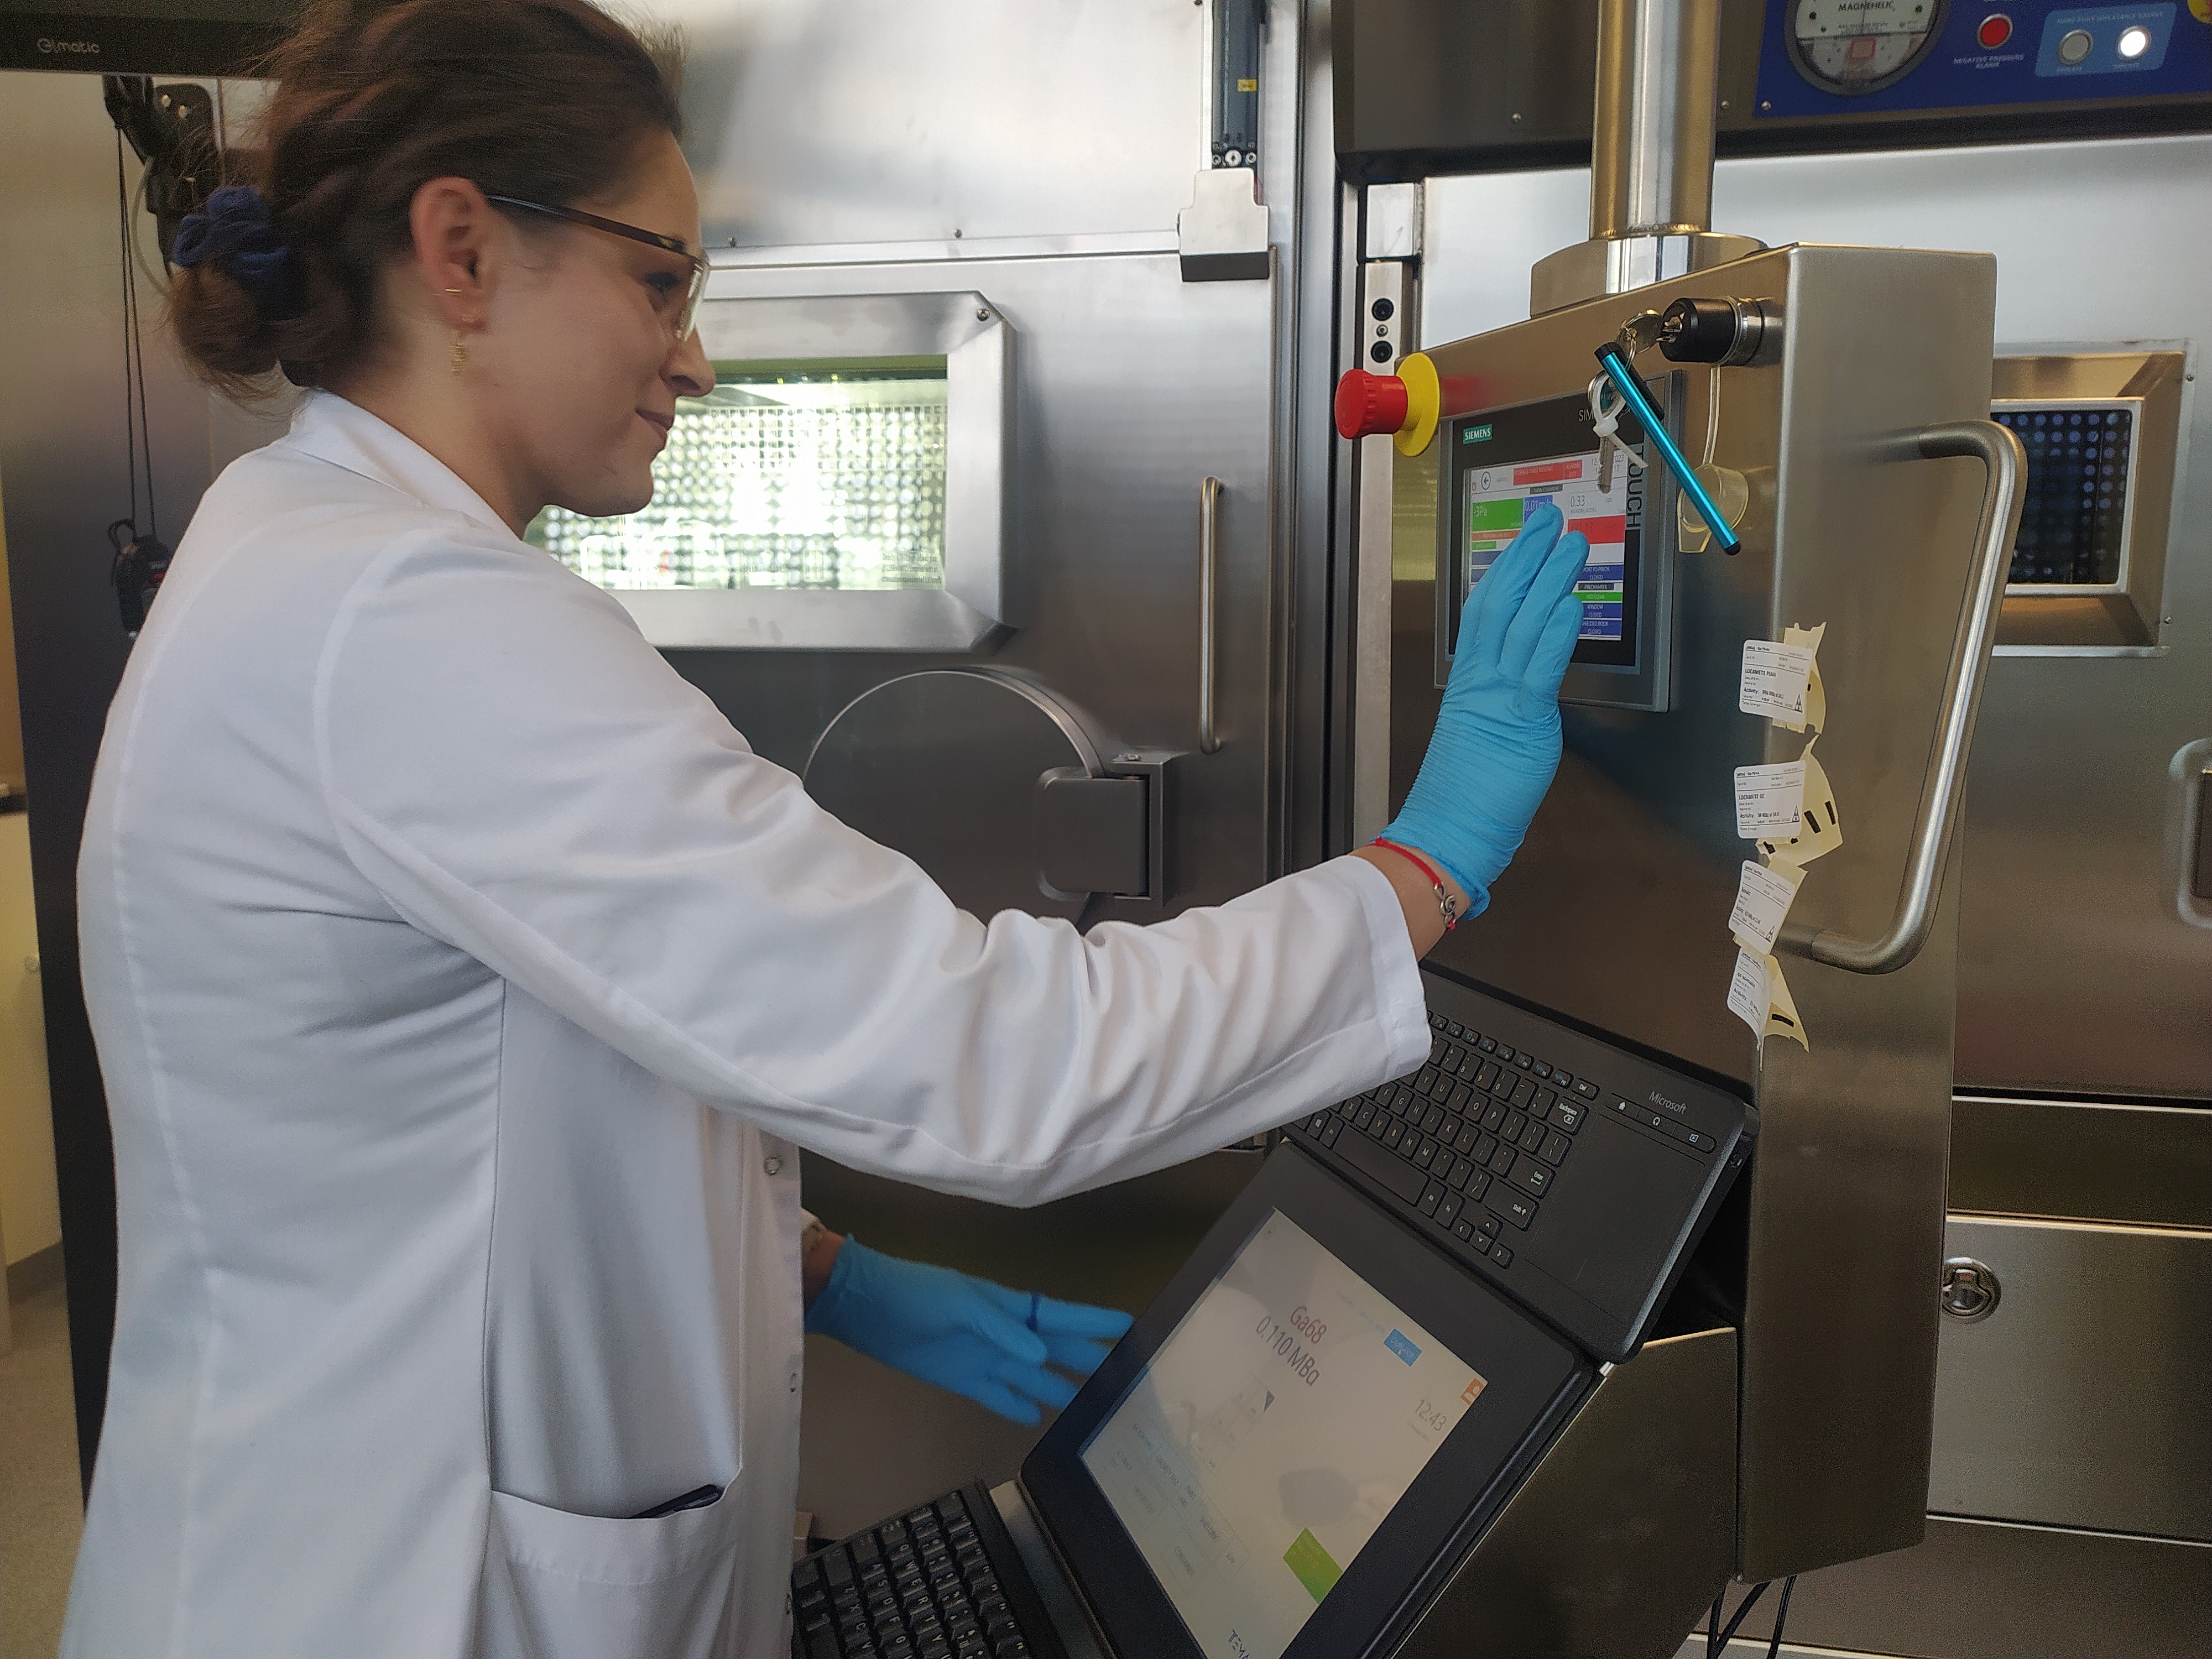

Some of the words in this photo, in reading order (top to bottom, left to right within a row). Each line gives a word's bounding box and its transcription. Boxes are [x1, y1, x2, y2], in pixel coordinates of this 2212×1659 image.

[1465, 427, 1491, 441] SIEMENS
[1424, 1076, 1430, 1084] Y
[1648, 1091, 1687, 1115] Microsoft
[1413, 1106, 1420, 1114] H
[1446, 1124, 1452, 1133] K
[1463, 1134, 1468, 1142] L
[1406, 1138, 1413, 1147] N
[1422, 1148, 1430, 1156] M
[1290, 1305, 1327, 1344] Ga68
[1255, 1315, 1294, 1356] 0.110
[1286, 1345, 1321, 1387] MBq
[1414, 1399, 1447, 1431] 12:43
[912, 1578, 922, 1586] E
[918, 1596, 928, 1604] R
[932, 1634, 943, 1642] Y
